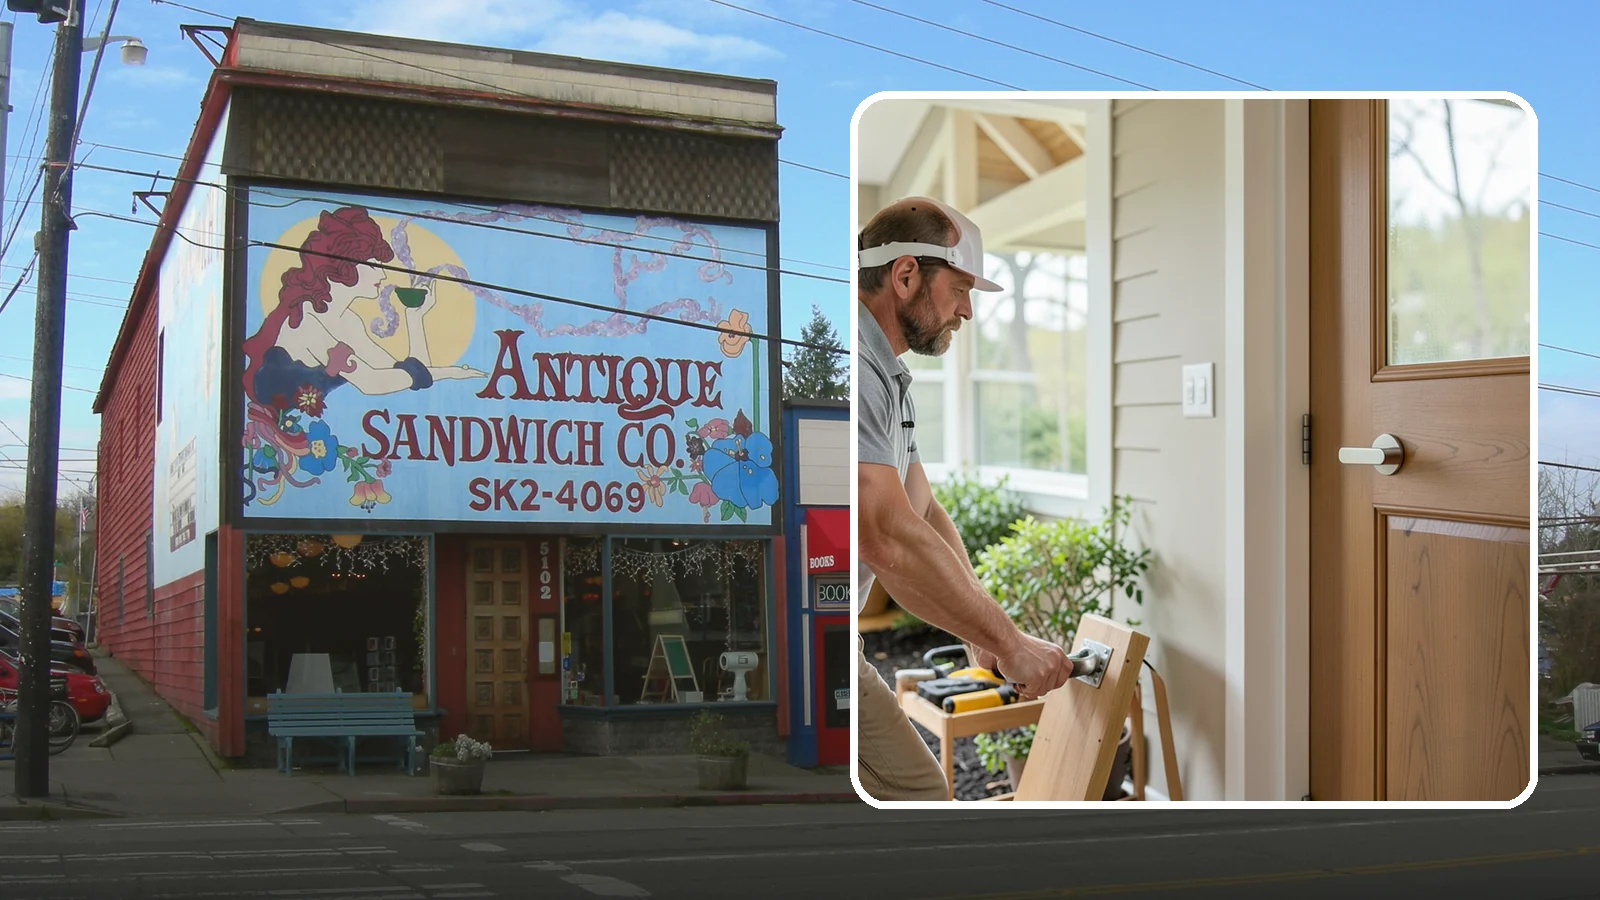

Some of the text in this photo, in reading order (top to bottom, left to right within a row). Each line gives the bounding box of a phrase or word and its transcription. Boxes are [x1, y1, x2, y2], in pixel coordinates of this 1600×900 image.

[475, 328, 724, 420] ANTIQUE
[361, 408, 685, 469] SANDWICH CO.
[468, 477, 645, 513] SK2-4069
[539, 541, 551, 600] 5102
[809, 555, 835, 569] BOOKS
